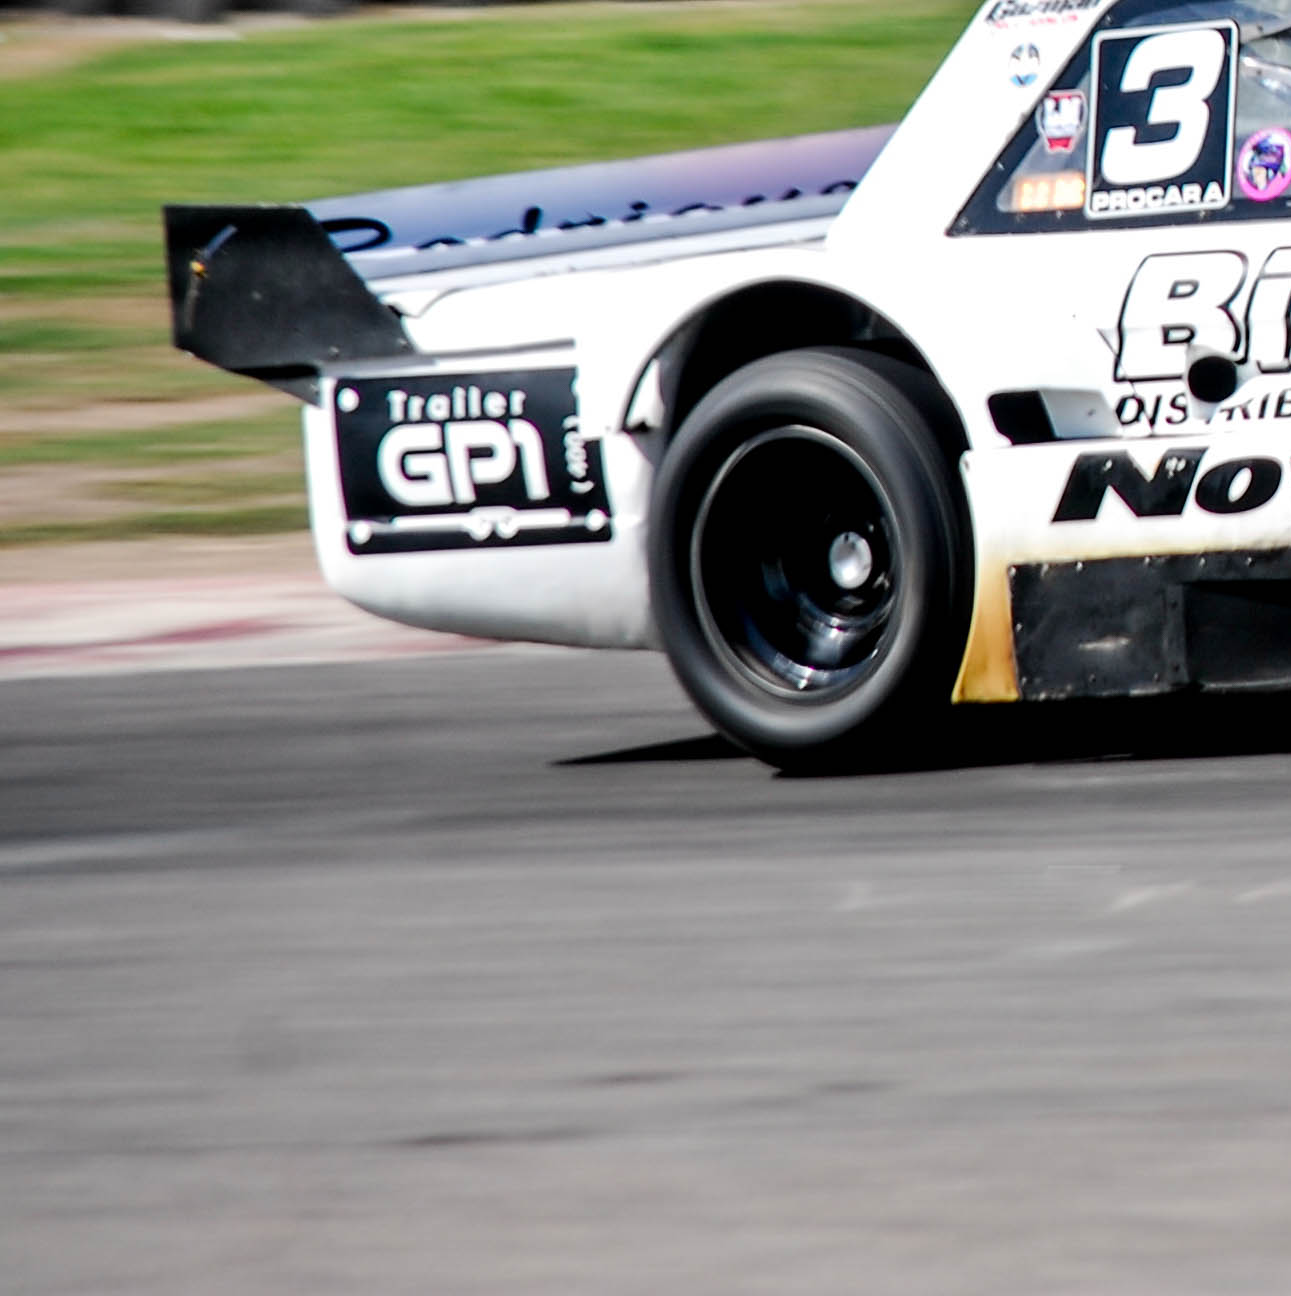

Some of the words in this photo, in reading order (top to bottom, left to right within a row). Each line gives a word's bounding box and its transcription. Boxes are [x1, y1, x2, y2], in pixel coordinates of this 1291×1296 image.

[1102, 29, 1225, 184] 3
[387, 385, 526, 422] Trailer
[377, 418, 550, 506] GP1
